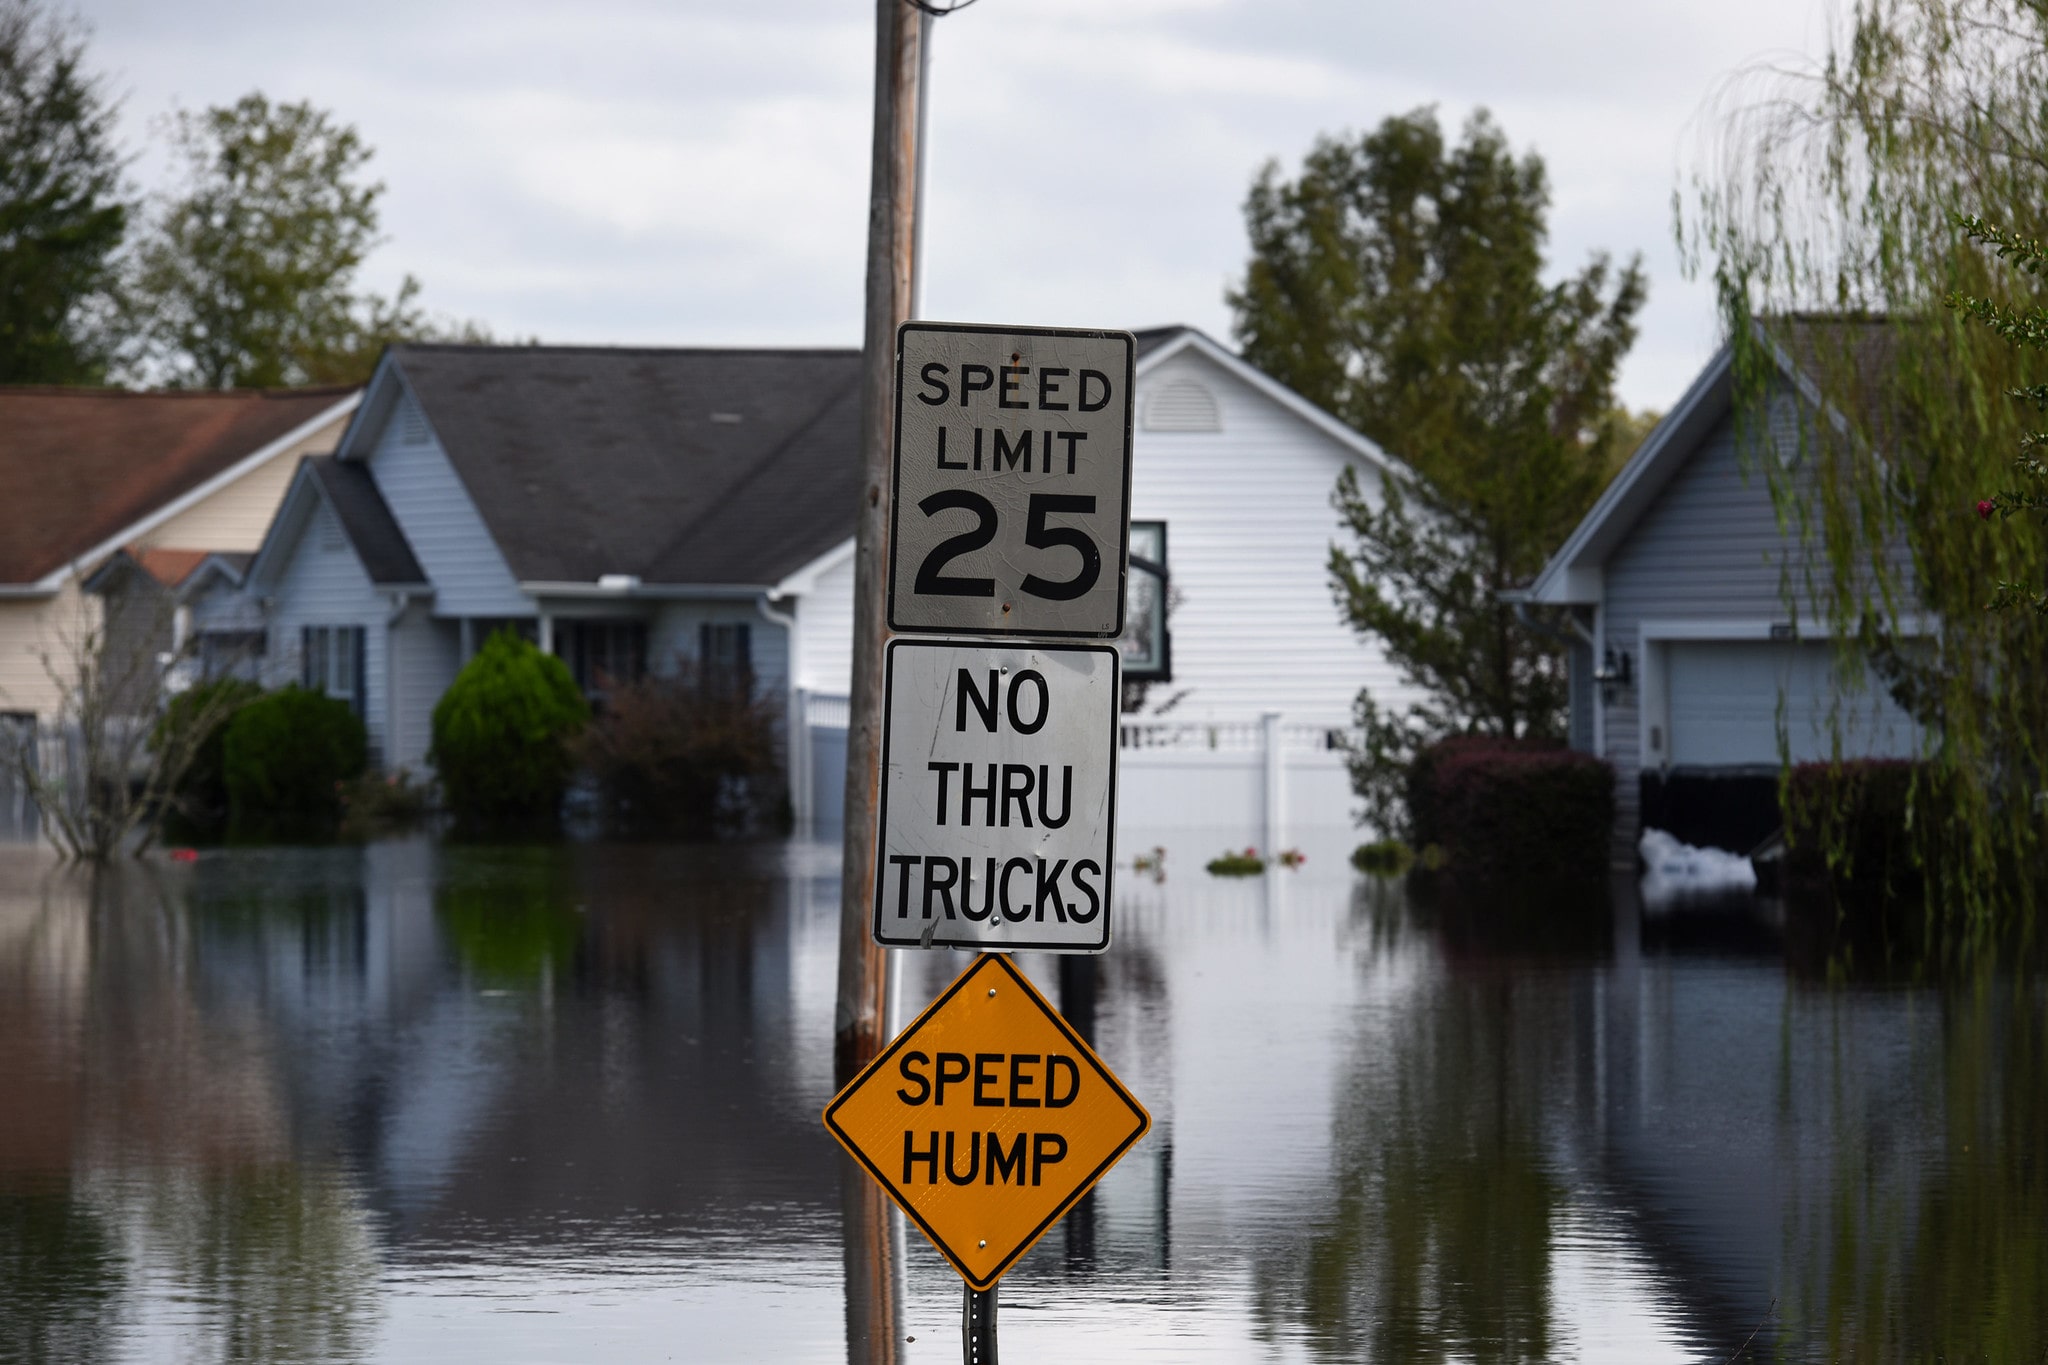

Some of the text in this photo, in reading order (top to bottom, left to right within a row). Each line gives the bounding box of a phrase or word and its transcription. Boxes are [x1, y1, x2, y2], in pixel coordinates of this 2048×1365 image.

[916, 362, 1112, 413] SPEED
[936, 426, 1088, 475] LIMIT
[913, 489, 1102, 602] 25
[955, 668, 1050, 736] NO
[927, 761, 1073, 830] THRU
[889, 854, 1102, 924] TRUCKS
[896, 1050, 1081, 1109] SPEED
[902, 1130, 1068, 1187] HUMP
